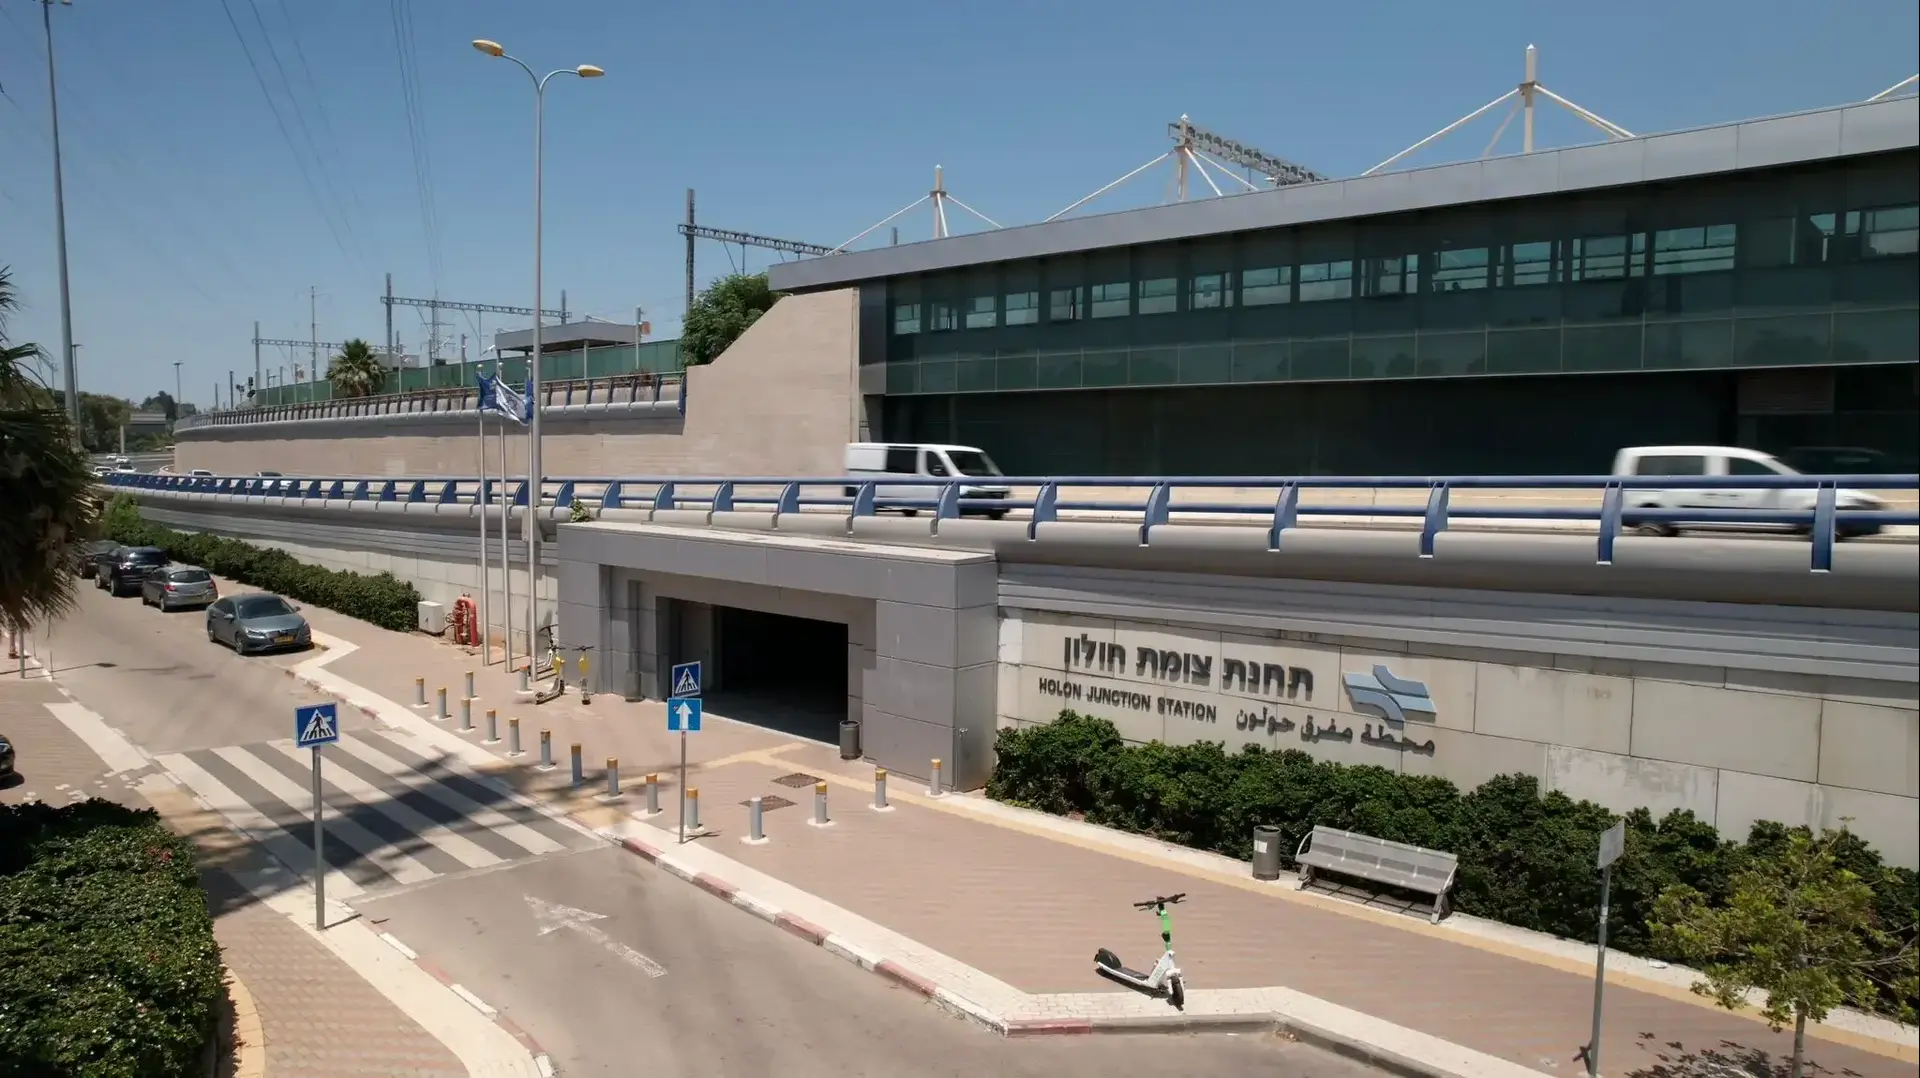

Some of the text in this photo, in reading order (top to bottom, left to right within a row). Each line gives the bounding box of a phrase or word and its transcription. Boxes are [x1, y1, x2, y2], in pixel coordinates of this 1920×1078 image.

[1064, 633, 1313, 695] תחנת צומת חולון
[1039, 677, 1217, 723] HOLON JUNCTION STATION
[1236, 706, 1435, 756] محطة مفرق حولون
